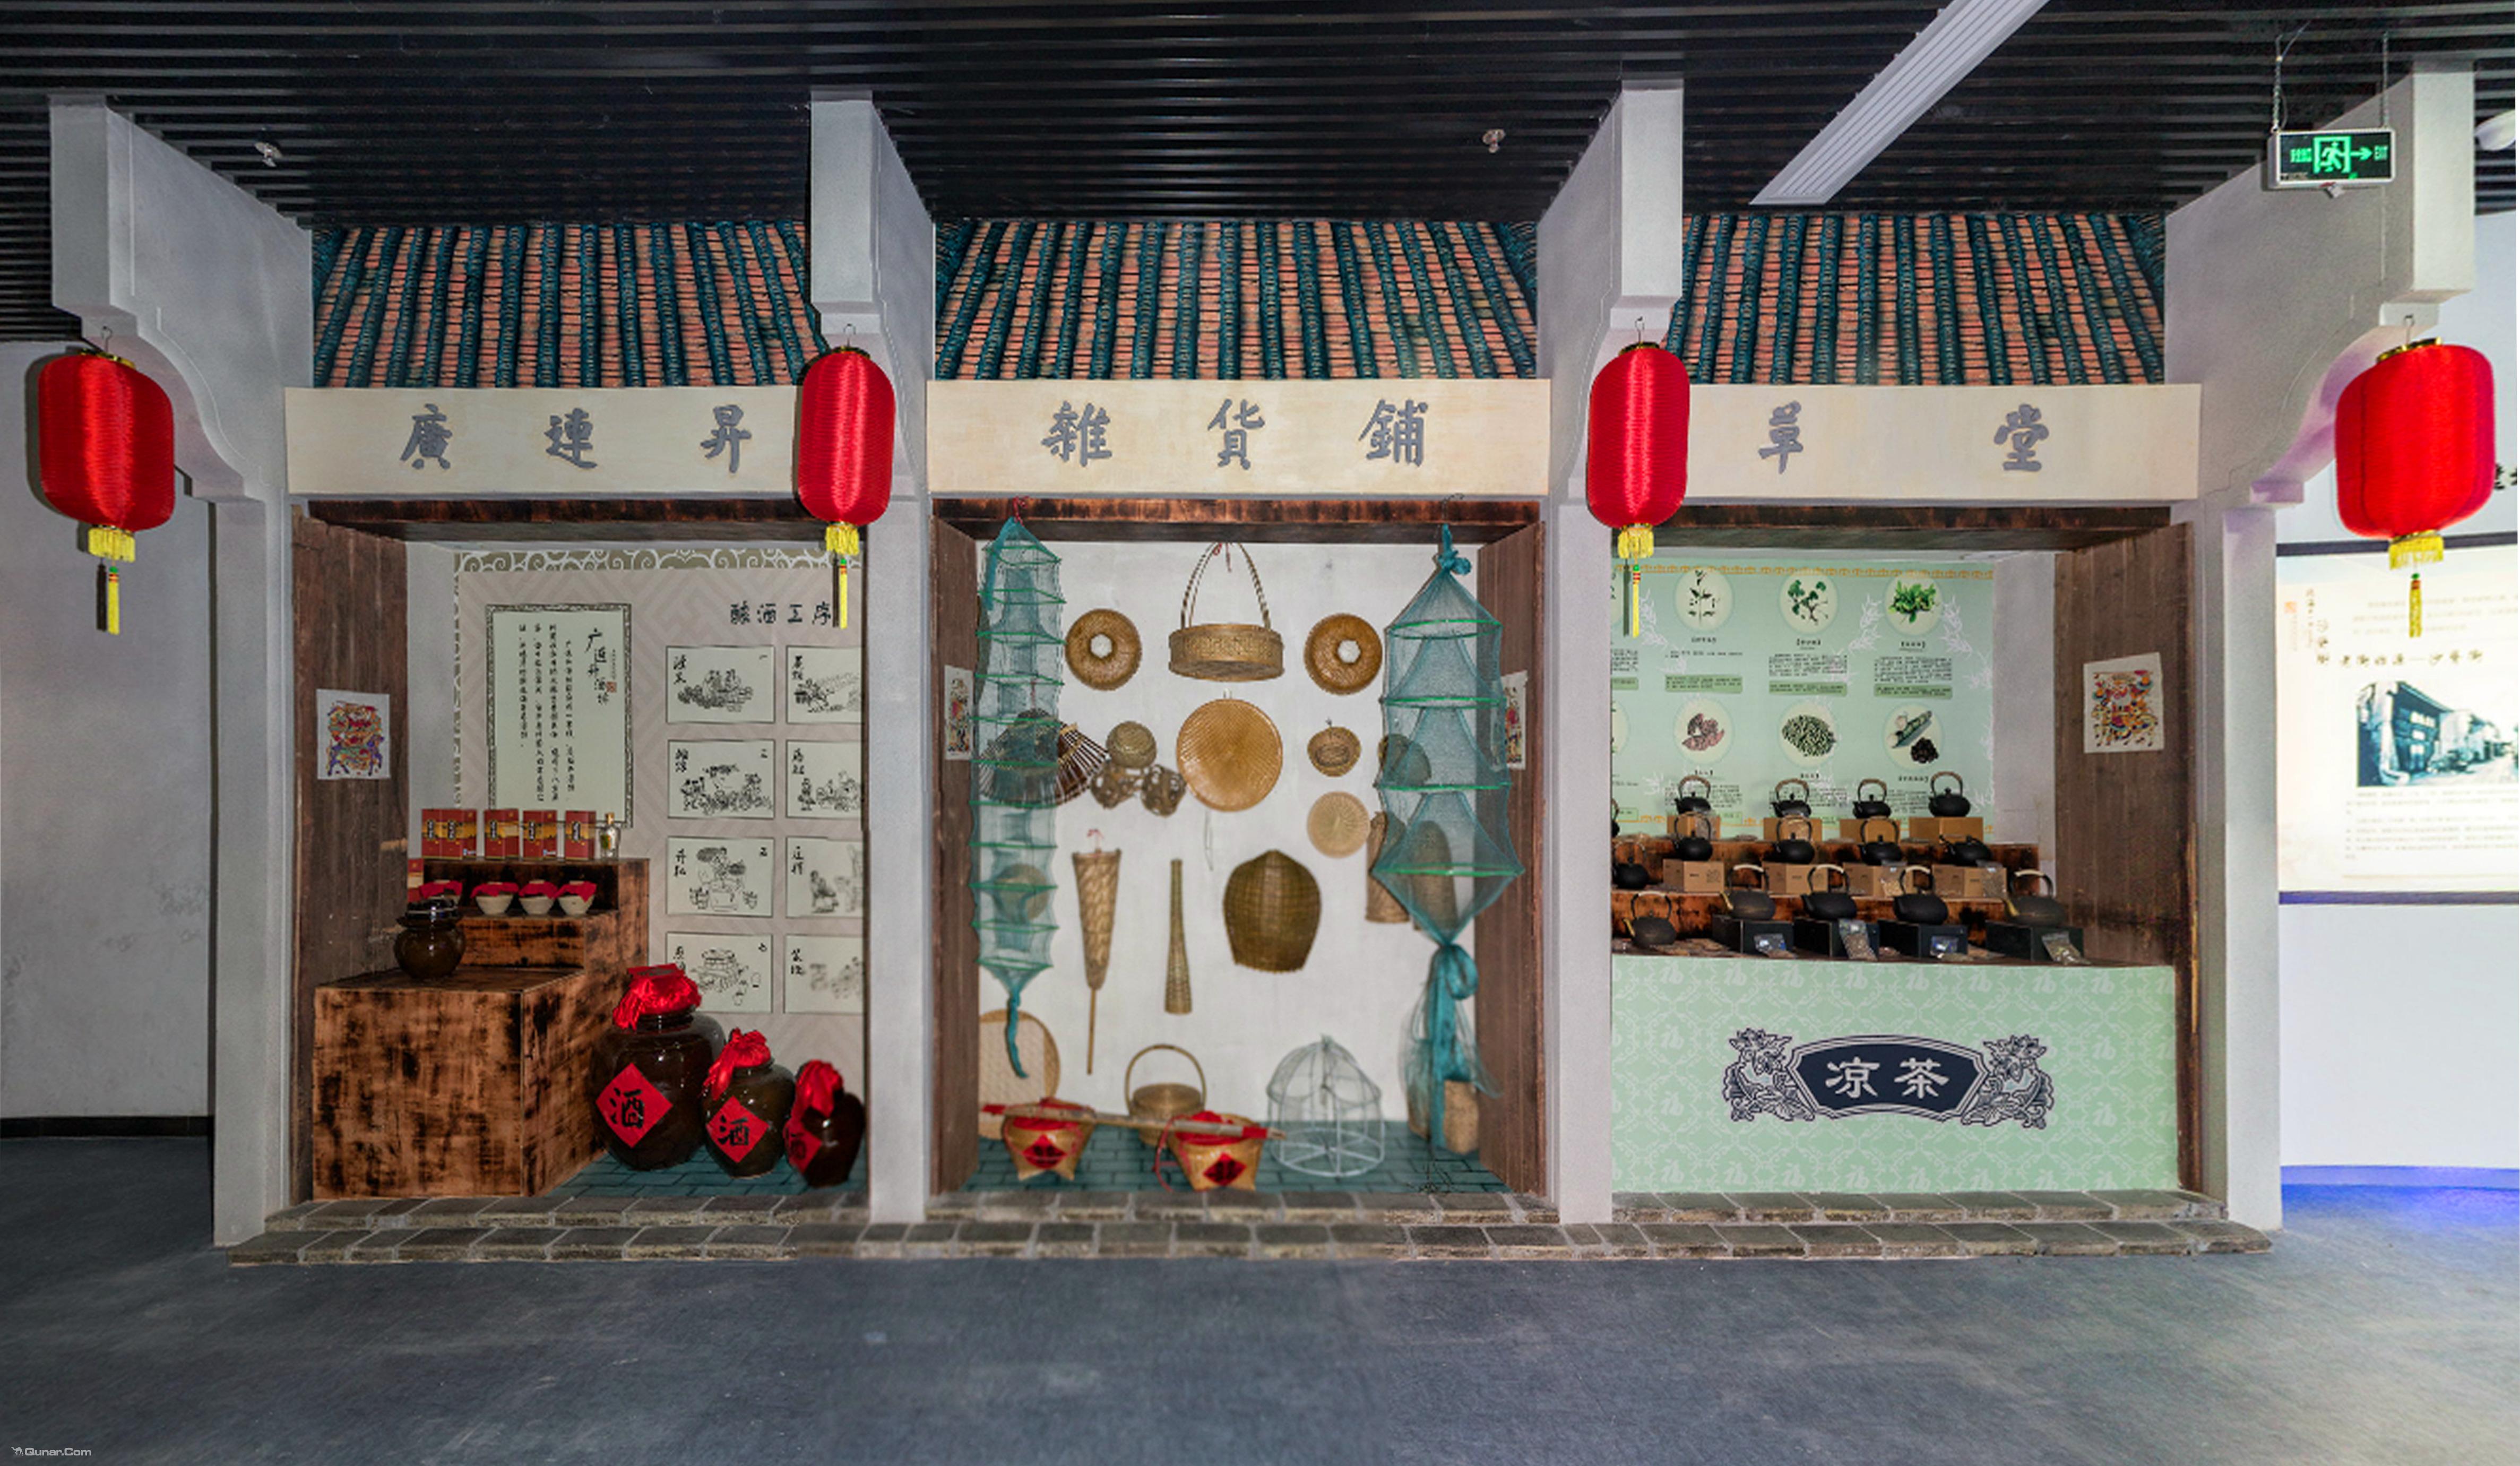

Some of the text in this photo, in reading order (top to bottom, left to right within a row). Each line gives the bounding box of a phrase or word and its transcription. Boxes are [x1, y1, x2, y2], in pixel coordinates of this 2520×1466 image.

[400, 404, 751, 472] 廣連昇
[1041, 398, 1428, 469] 雜貨鋪
[1825, 1057, 1949, 1099] 凉茶
[609, 1088, 645, 1129] 酒
[717, 1115, 750, 1146] 酒
